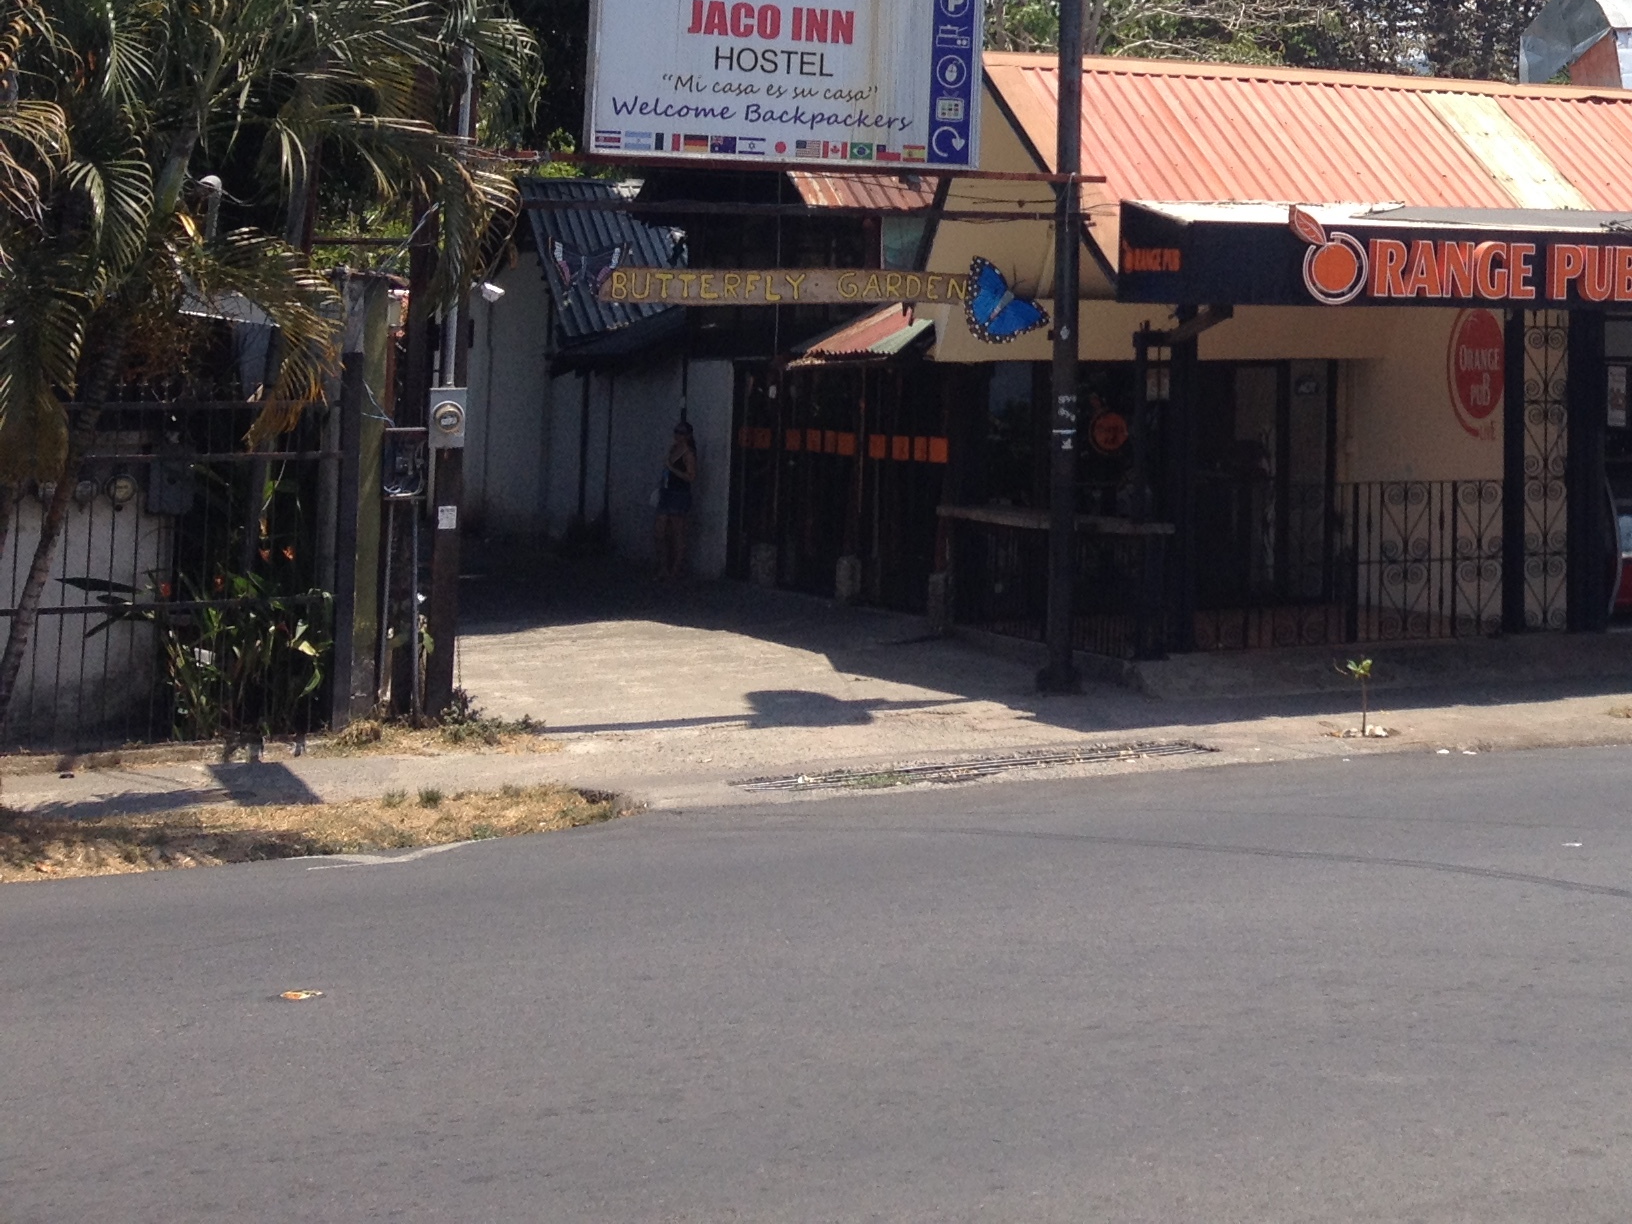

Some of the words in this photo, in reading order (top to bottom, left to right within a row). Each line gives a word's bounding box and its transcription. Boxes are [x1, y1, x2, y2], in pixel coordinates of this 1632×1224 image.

[687, 0, 781, 40] JACO
[791, 7, 854, 44] INN
[714, 46, 834, 77] HOSTEL
[712, 81, 760, 95] casa
[766, 83, 788, 97] es
[793, 85, 819, 101] su
[612, 96, 737, 121] Welcome
[744, 103, 913, 131] Backpackers
[611, 271, 806, 301] BUTTERFLY
[836, 271, 968, 300] GARDEN
[1460, 344, 1500, 371] ORANGE
